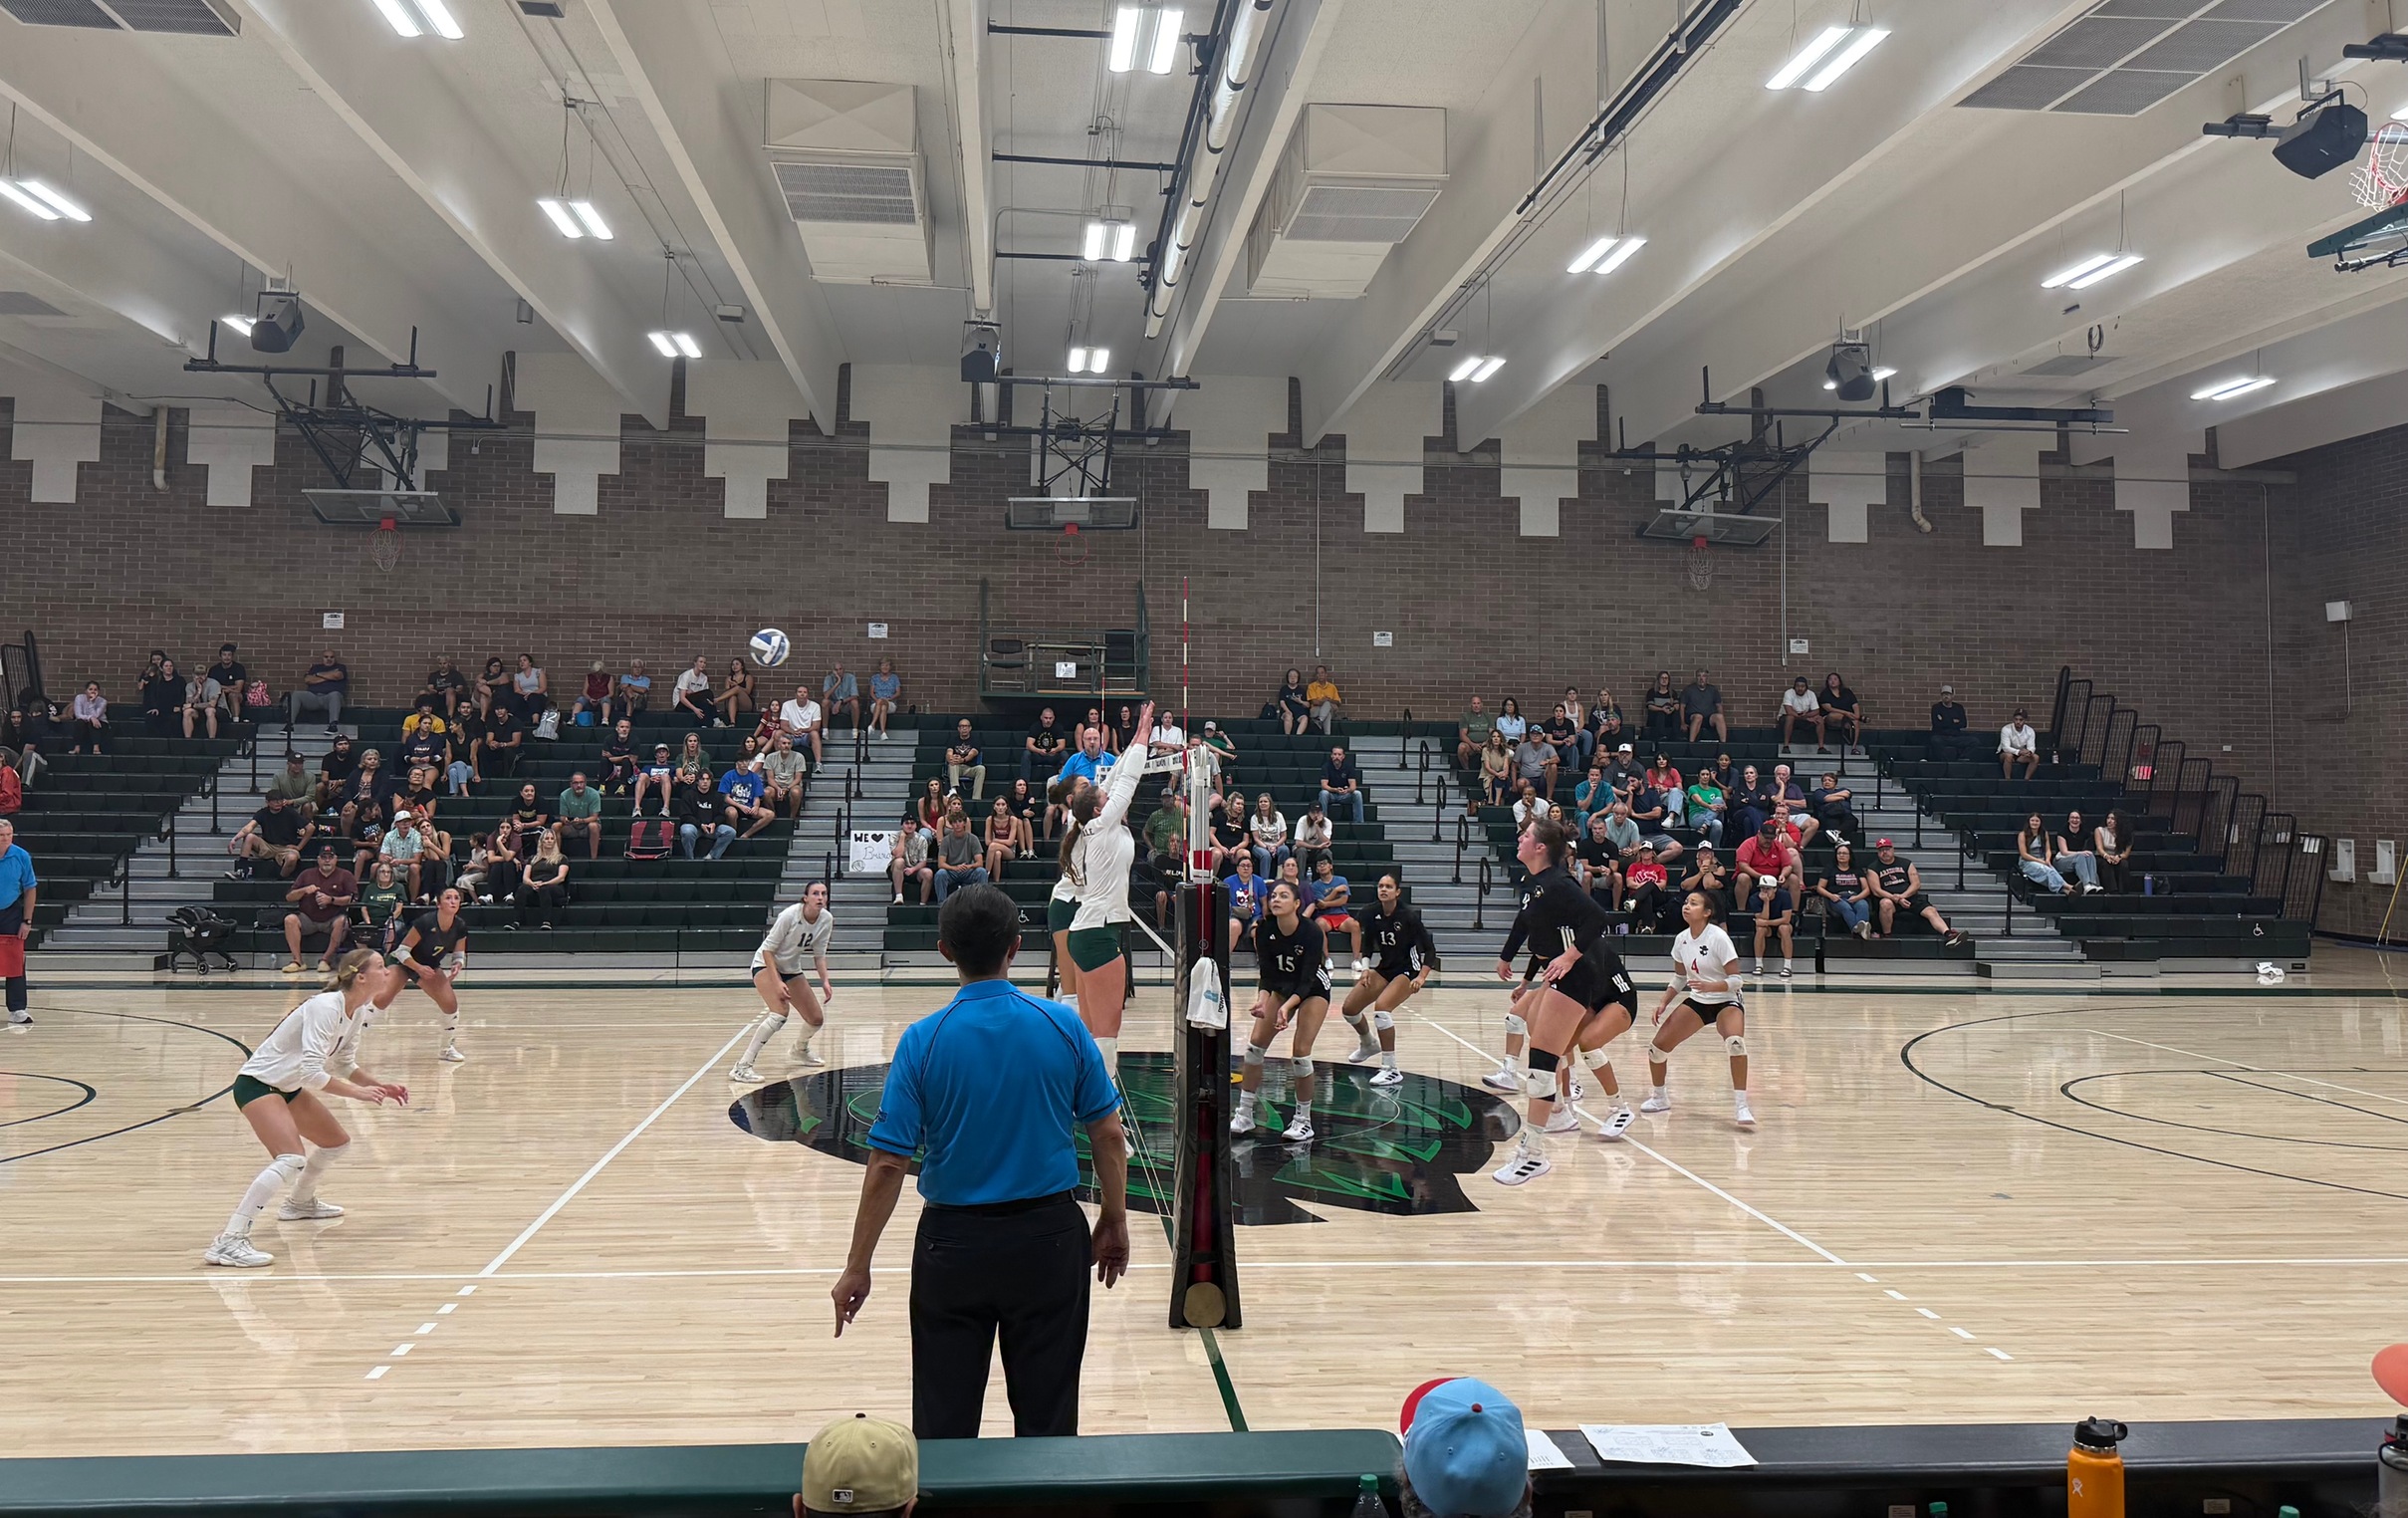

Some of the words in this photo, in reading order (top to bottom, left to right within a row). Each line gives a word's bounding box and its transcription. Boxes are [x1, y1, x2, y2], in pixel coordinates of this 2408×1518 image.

[853, 833, 869, 843] WE
[797, 932, 814, 947] 12
[1379, 930, 1396, 946] 13
[431, 945, 445, 957] 7
[1276, 953, 1296, 973] 15
[1690, 957, 1700, 975] 4
